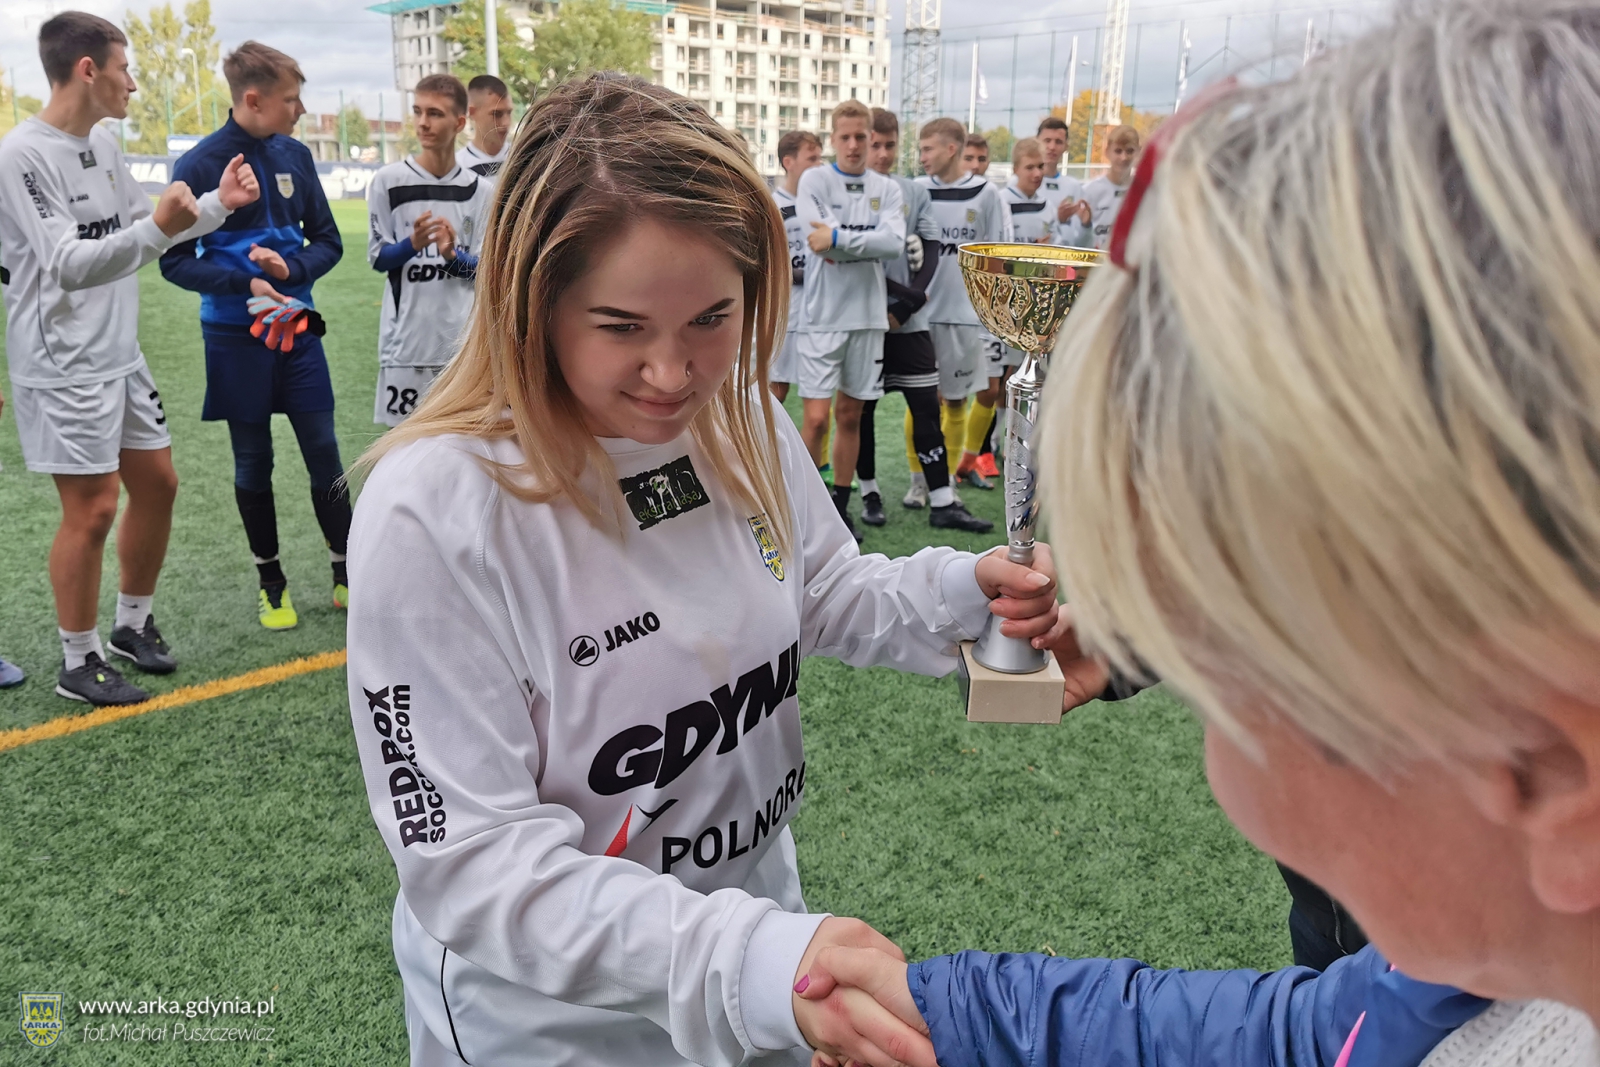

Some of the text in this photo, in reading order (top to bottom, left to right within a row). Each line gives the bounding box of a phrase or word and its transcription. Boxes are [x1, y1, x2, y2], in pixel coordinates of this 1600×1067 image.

[386, 385, 418, 416] 28
[604, 611, 661, 652] JAKO
[588, 639, 801, 796] GDYNI
